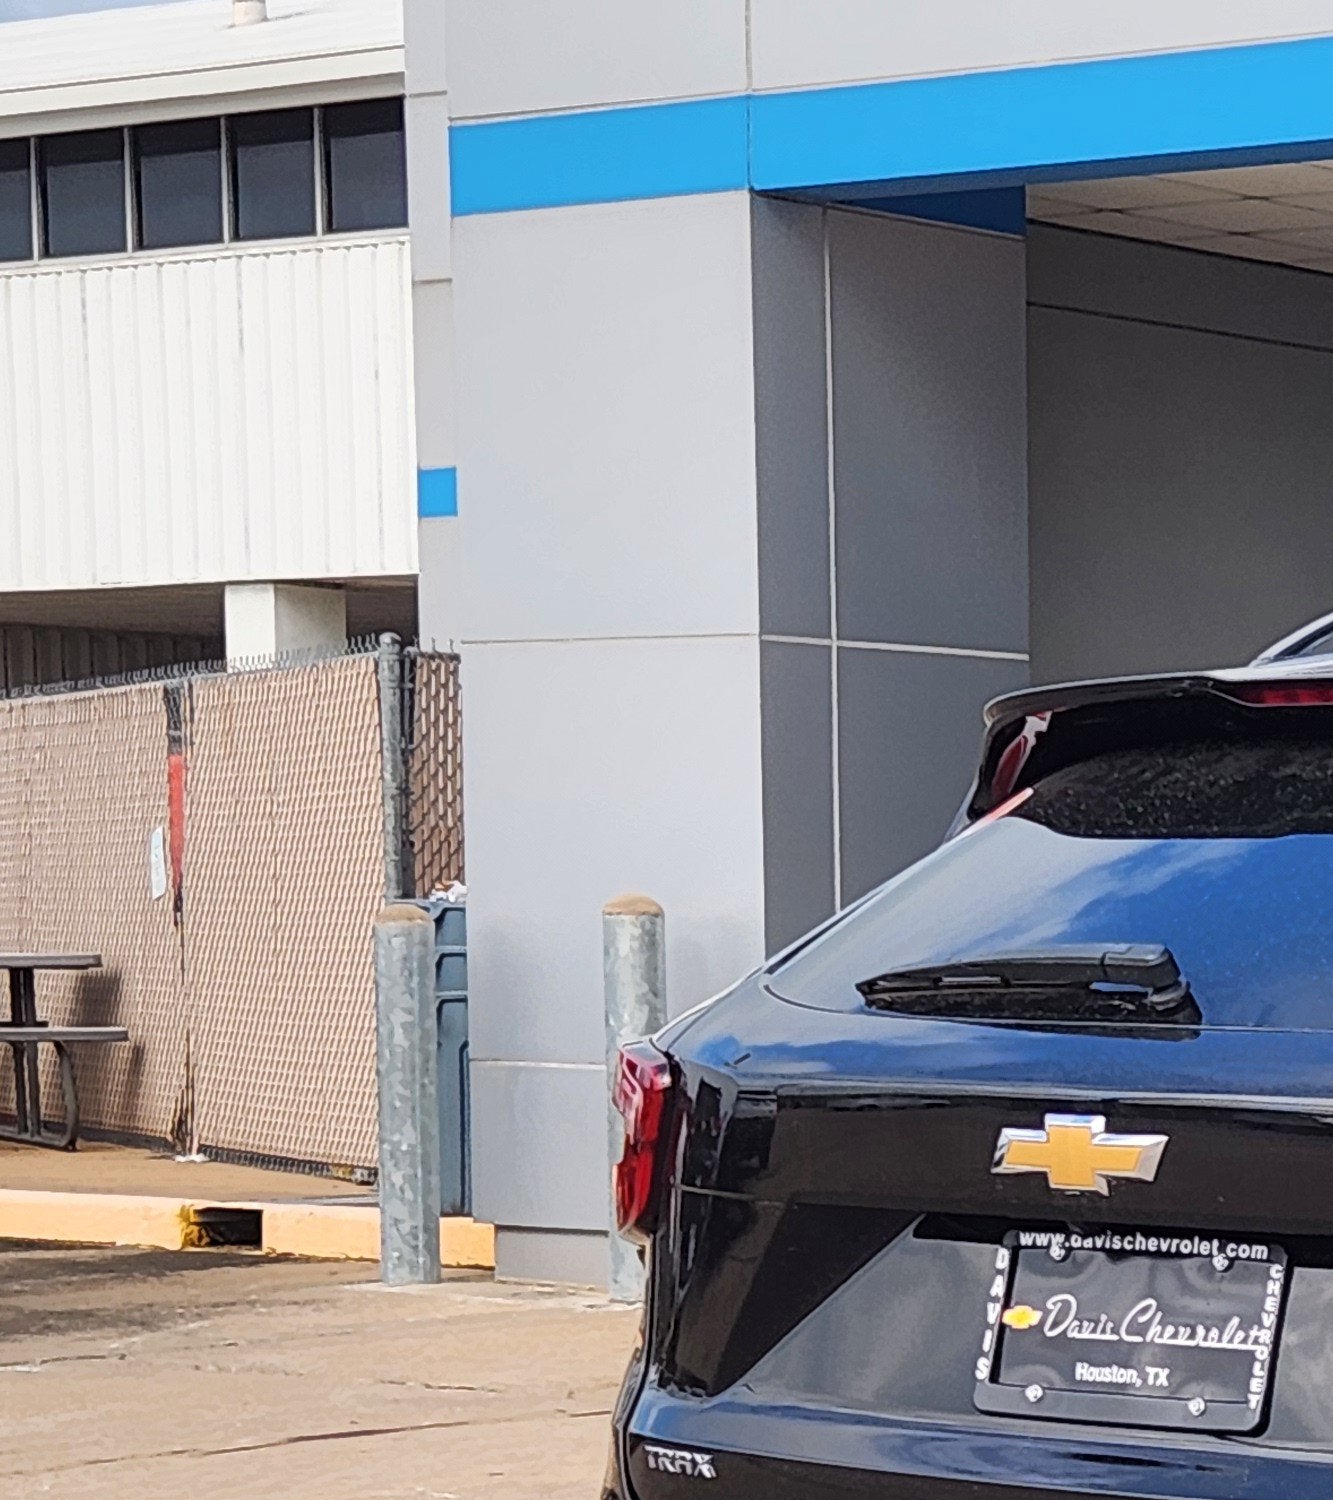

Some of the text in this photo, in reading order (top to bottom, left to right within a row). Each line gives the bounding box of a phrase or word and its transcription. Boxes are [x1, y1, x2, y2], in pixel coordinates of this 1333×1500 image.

[974, 1248, 1010, 1381] DAVIS
[1044, 1294, 1271, 1351] Davis Chevrolet
[1075, 1362, 1171, 1388] Houston, TX
[644, 1444, 718, 1479] TRAX
